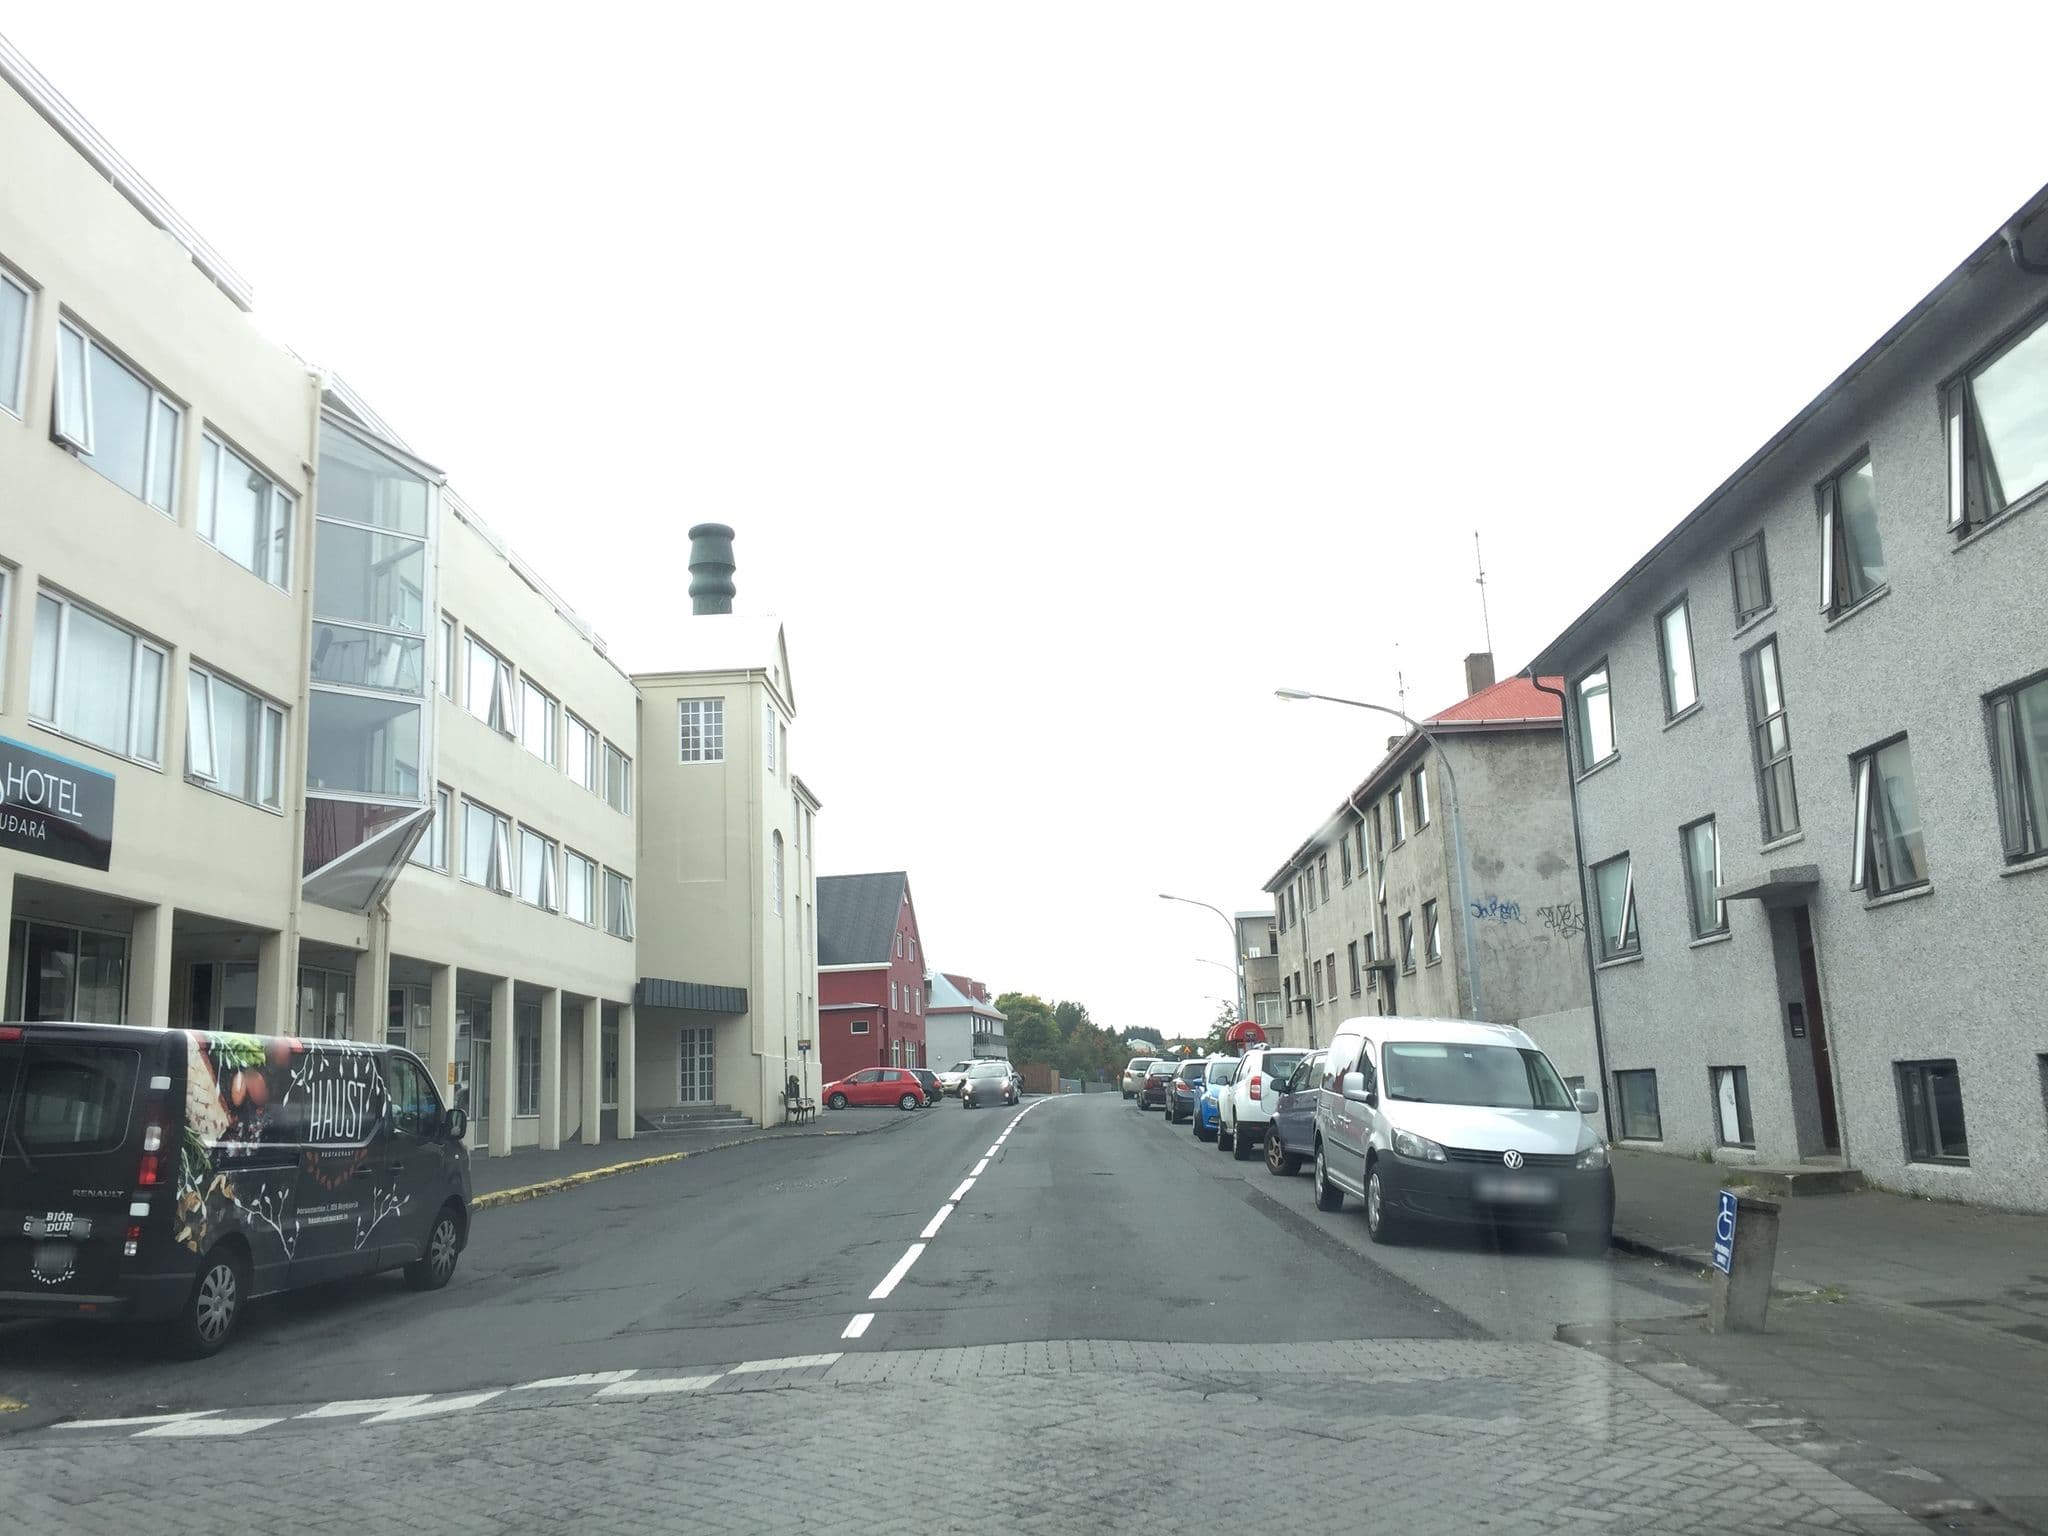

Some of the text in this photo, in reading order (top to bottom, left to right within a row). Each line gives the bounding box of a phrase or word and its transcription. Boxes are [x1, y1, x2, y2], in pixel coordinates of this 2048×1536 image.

[309, 1079, 366, 1142] HAUST
[72, 1189, 124, 1198] RENAULT
[46, 1210, 74, 1222] BJÓR
